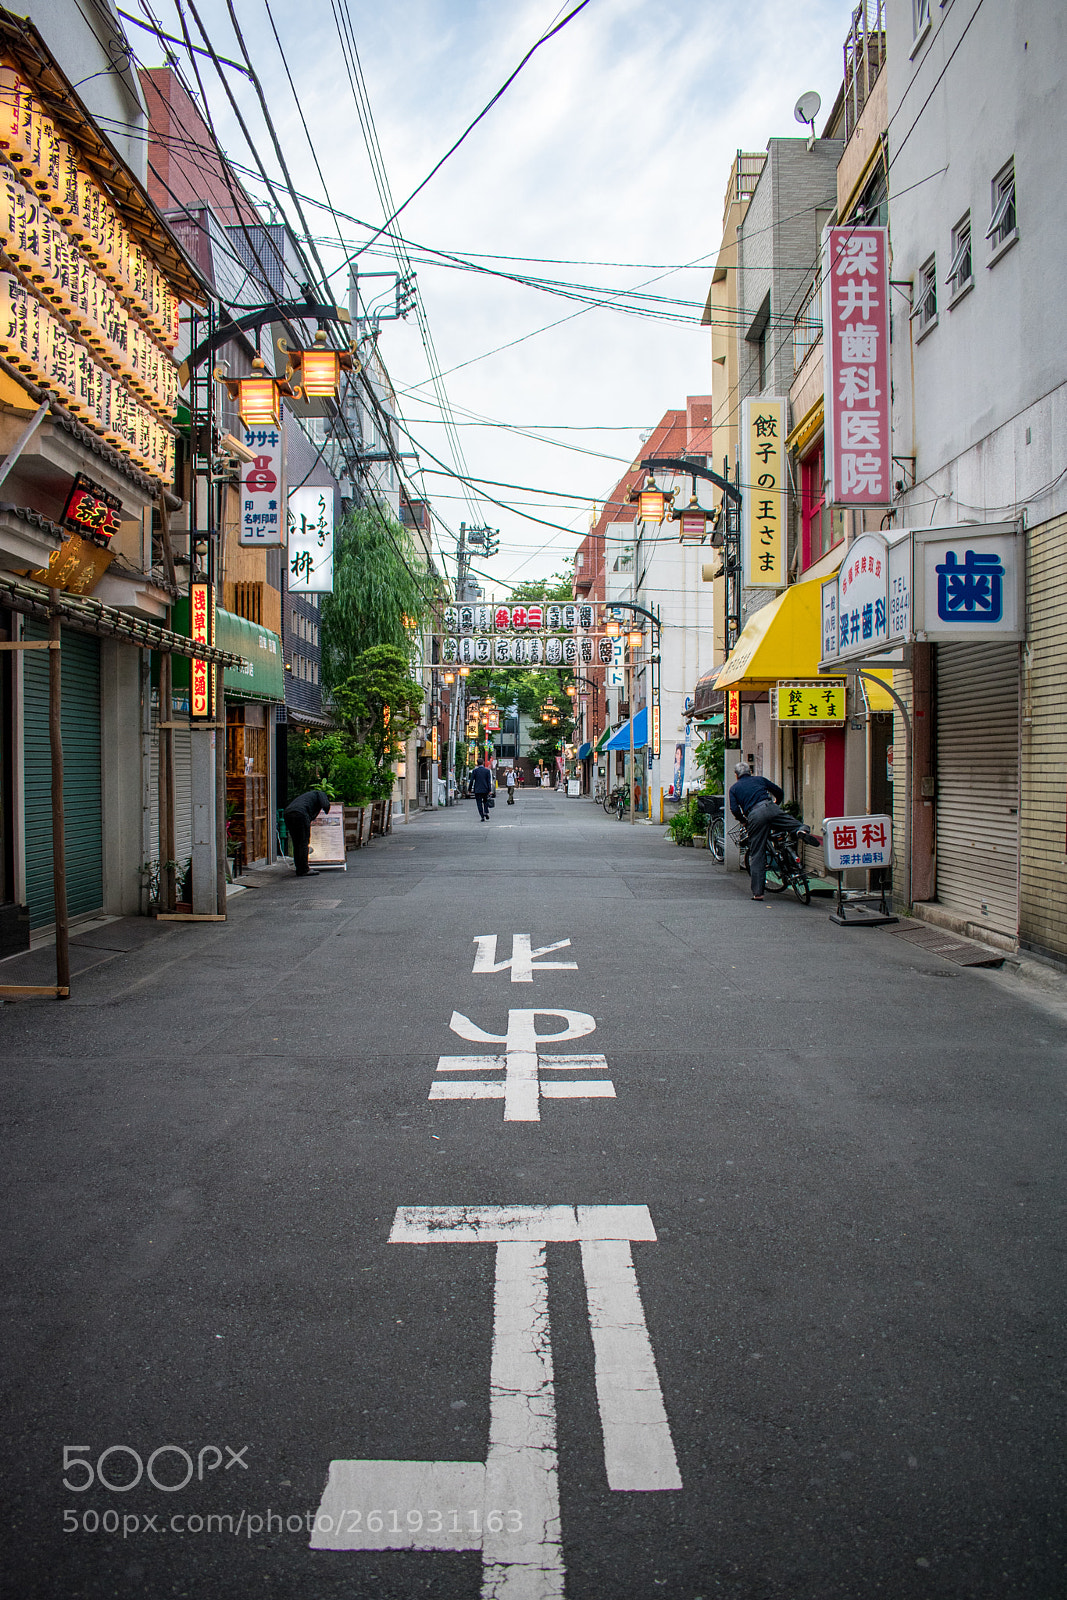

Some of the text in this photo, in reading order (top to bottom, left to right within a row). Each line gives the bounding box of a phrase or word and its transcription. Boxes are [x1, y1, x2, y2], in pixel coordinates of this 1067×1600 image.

[836, 235, 882, 495] 深井歯科医院
[244, 430, 279, 447] ササキ
[752, 414, 778, 572] 餃子の王さま
[244, 500, 278, 511] 印章
[244, 513, 278, 524] 名刺印刷
[317, 494, 330, 548] うなぎ
[244, 526, 277, 537] コピー
[290, 513, 316, 584] 小柳
[893, 576, 907, 594] TEL
[935, 549, 1006, 623] 歯
[825, 595, 836, 611] 一般
[840, 596, 887, 647] 深井歯科
[893, 614, 907, 632] 1831
[788, 689, 836, 703] 餃子
[787, 703, 837, 717] 王さま
[833, 822, 888, 850] 歯科
[839, 852, 884, 865] 深井歯科
